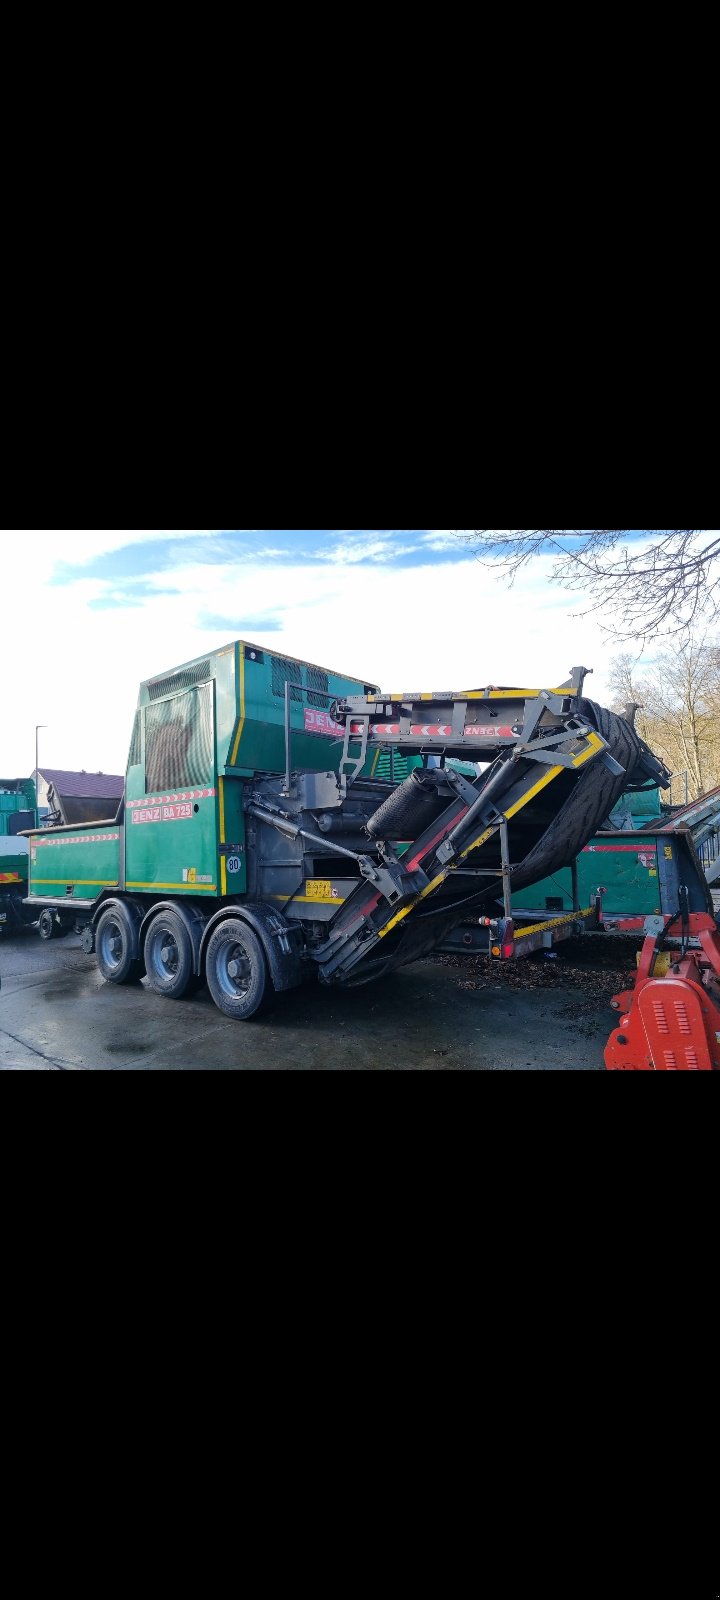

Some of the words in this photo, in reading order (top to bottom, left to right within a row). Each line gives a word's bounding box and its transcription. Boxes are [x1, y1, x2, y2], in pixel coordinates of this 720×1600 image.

[133, 809, 160, 822] JENZ
[163, 807, 174, 818] BA
[175, 805, 191, 817] 725
[229, 859, 239, 870] 80
